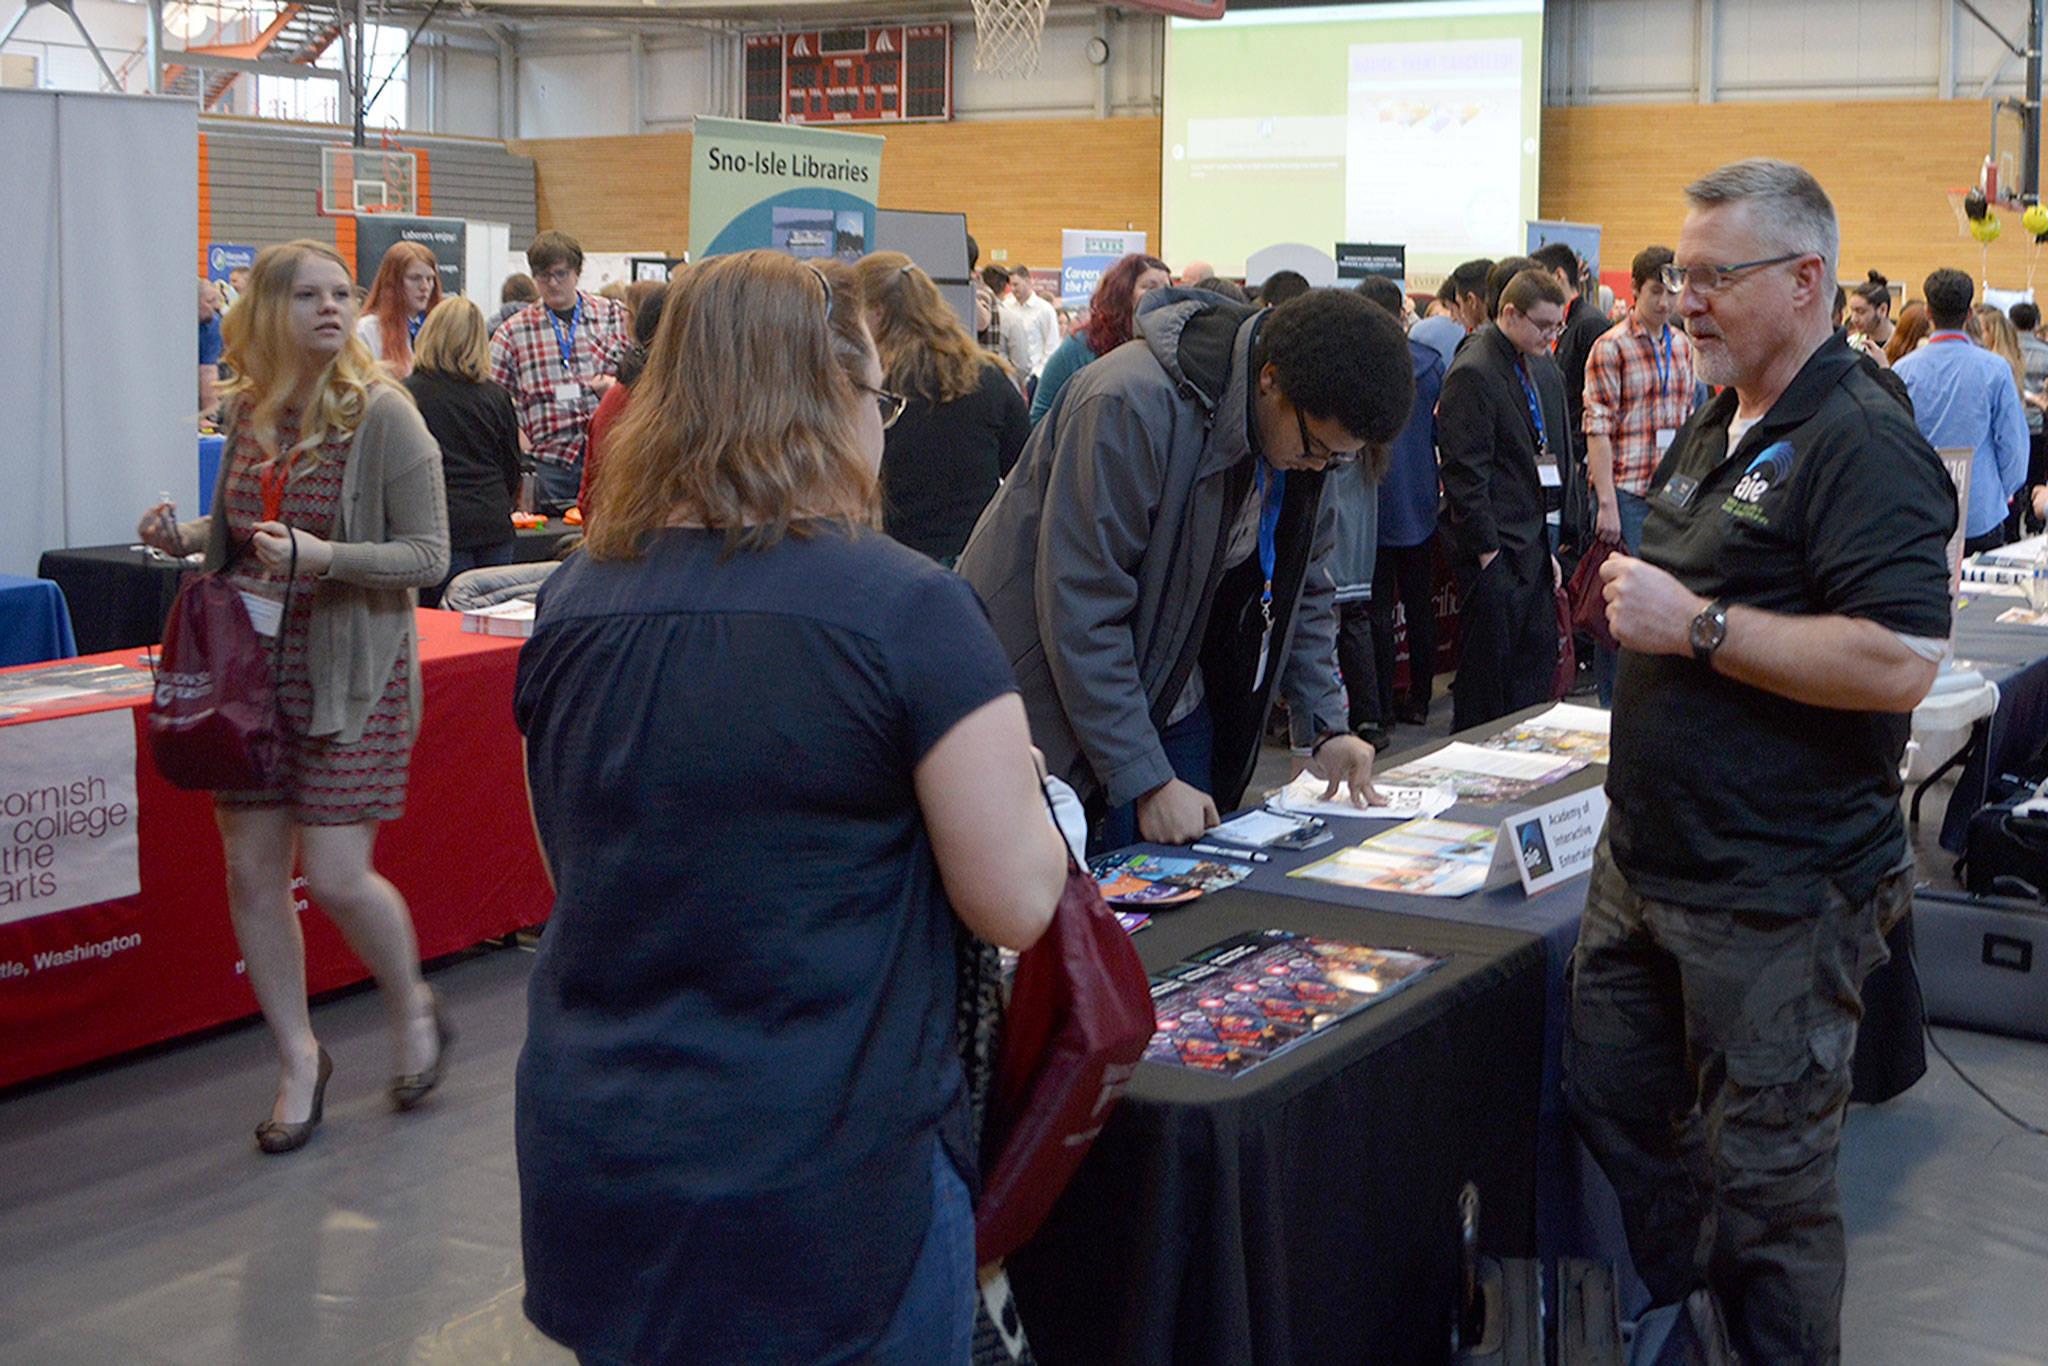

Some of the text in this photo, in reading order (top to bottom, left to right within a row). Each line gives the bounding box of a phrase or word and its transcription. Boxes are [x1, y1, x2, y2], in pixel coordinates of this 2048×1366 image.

[708, 146, 869, 183] Sno-Isle Libraries
[1733, 471, 1769, 503] aie
[0, 776, 106, 817] ornish
[14, 802, 128, 844] college
[3, 843, 55, 875] the
[0, 871, 57, 906] arts
[34, 932, 142, 971] Washington
